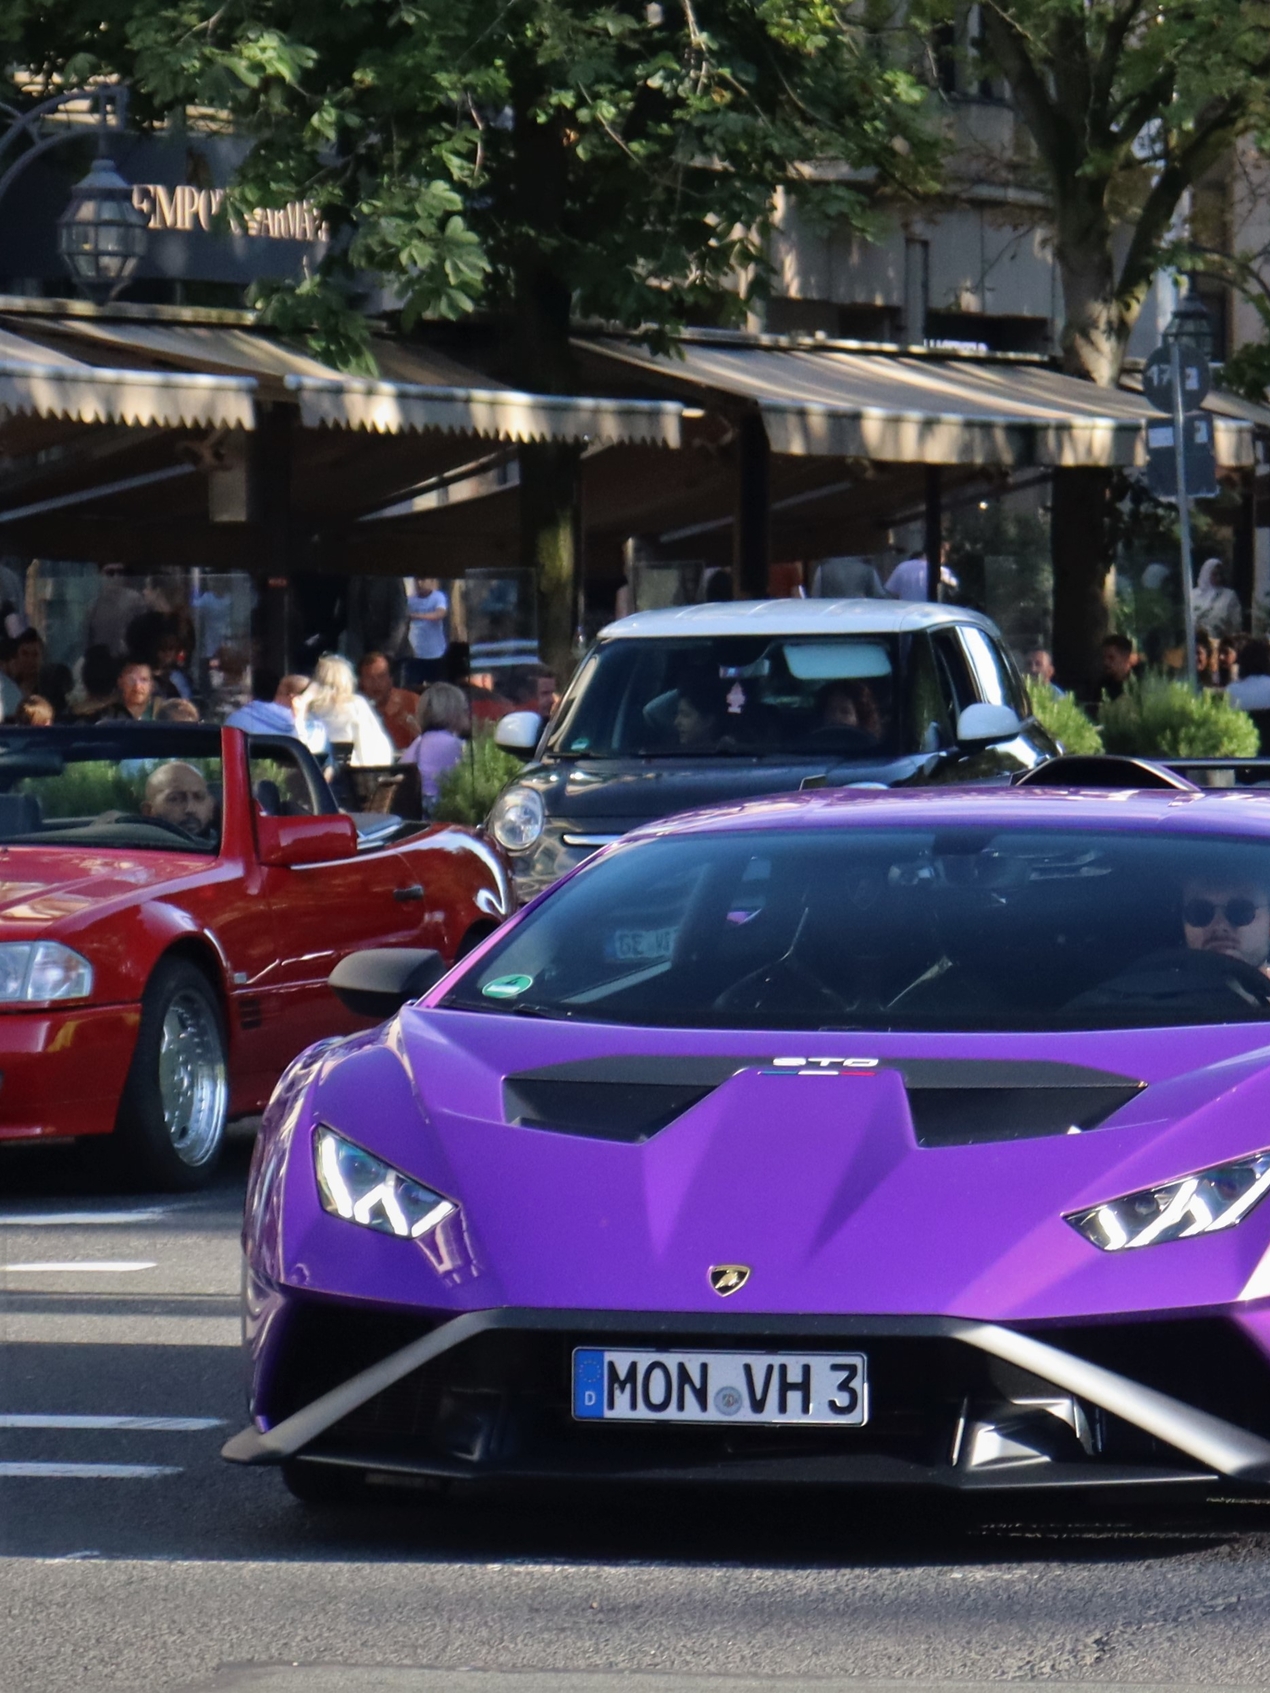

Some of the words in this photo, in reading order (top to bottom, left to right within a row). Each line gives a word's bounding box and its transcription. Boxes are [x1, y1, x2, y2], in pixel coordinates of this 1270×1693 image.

[772, 1057, 879, 1067] STO
[606, 1360, 709, 1413] MON
[742, 1362, 812, 1415] VH
[827, 1363, 859, 1416] 3
[583, 1390, 596, 1406] D
